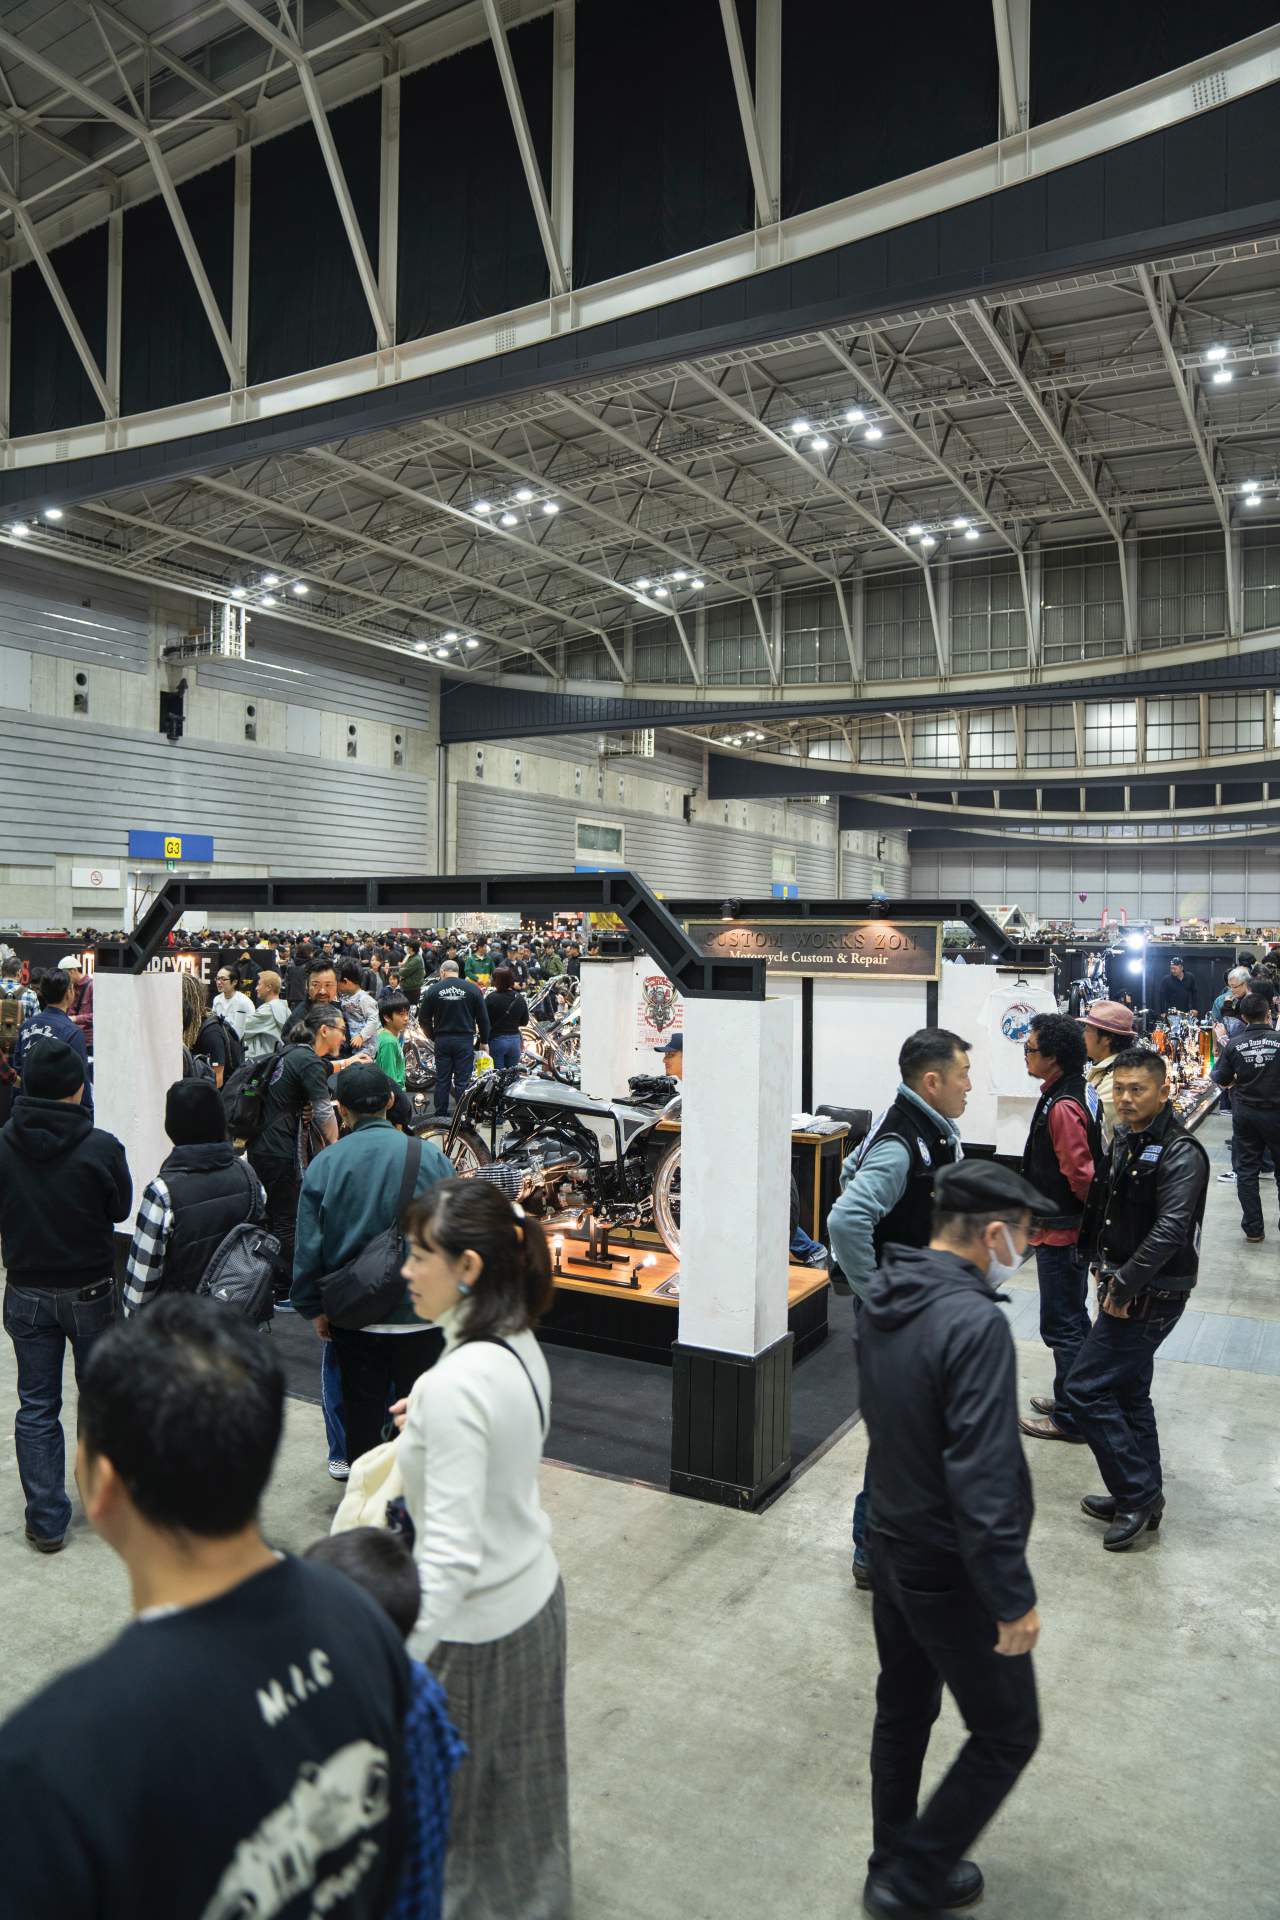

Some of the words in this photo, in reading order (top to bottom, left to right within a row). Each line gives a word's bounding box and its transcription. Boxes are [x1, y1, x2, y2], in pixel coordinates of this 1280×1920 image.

[166, 842, 180, 855] G3
[704, 931, 785, 948] CUSTOM
[792, 932, 865, 950] WORKS
[874, 933, 919, 951] ZON
[791, 951, 834, 963] Custom
[837, 952, 848, 963] &
[850, 952, 889, 968] Repair
